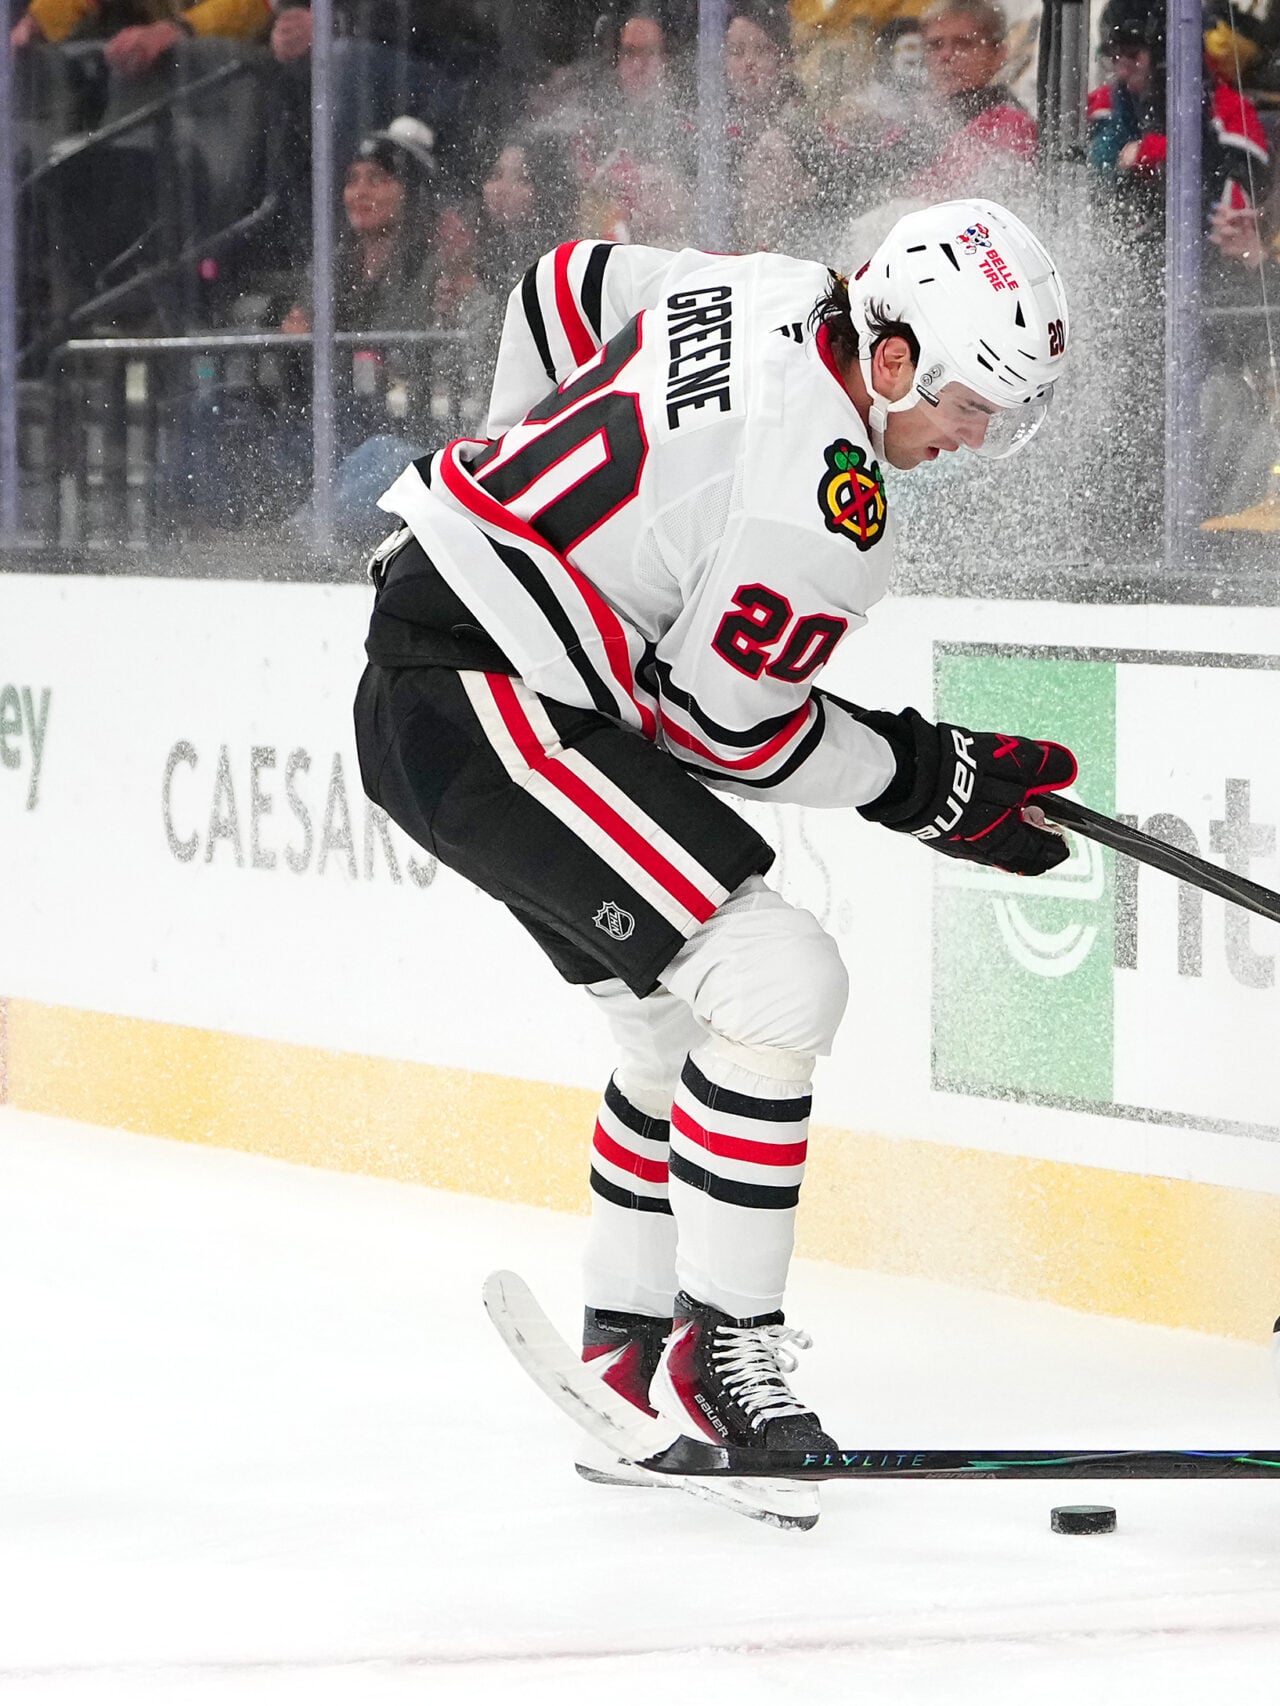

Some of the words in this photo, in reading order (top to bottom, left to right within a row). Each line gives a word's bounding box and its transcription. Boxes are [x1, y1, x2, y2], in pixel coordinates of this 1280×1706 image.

[978, 259, 1006, 292] TIRE
[986, 249, 1019, 291] BELLE
[666, 285, 733, 431] GREENE
[1048, 318, 1066, 357] 20
[711, 582, 849, 684] 20
[911, 729, 978, 840] AUER
[803, 1454, 926, 1467] FLYLITE
